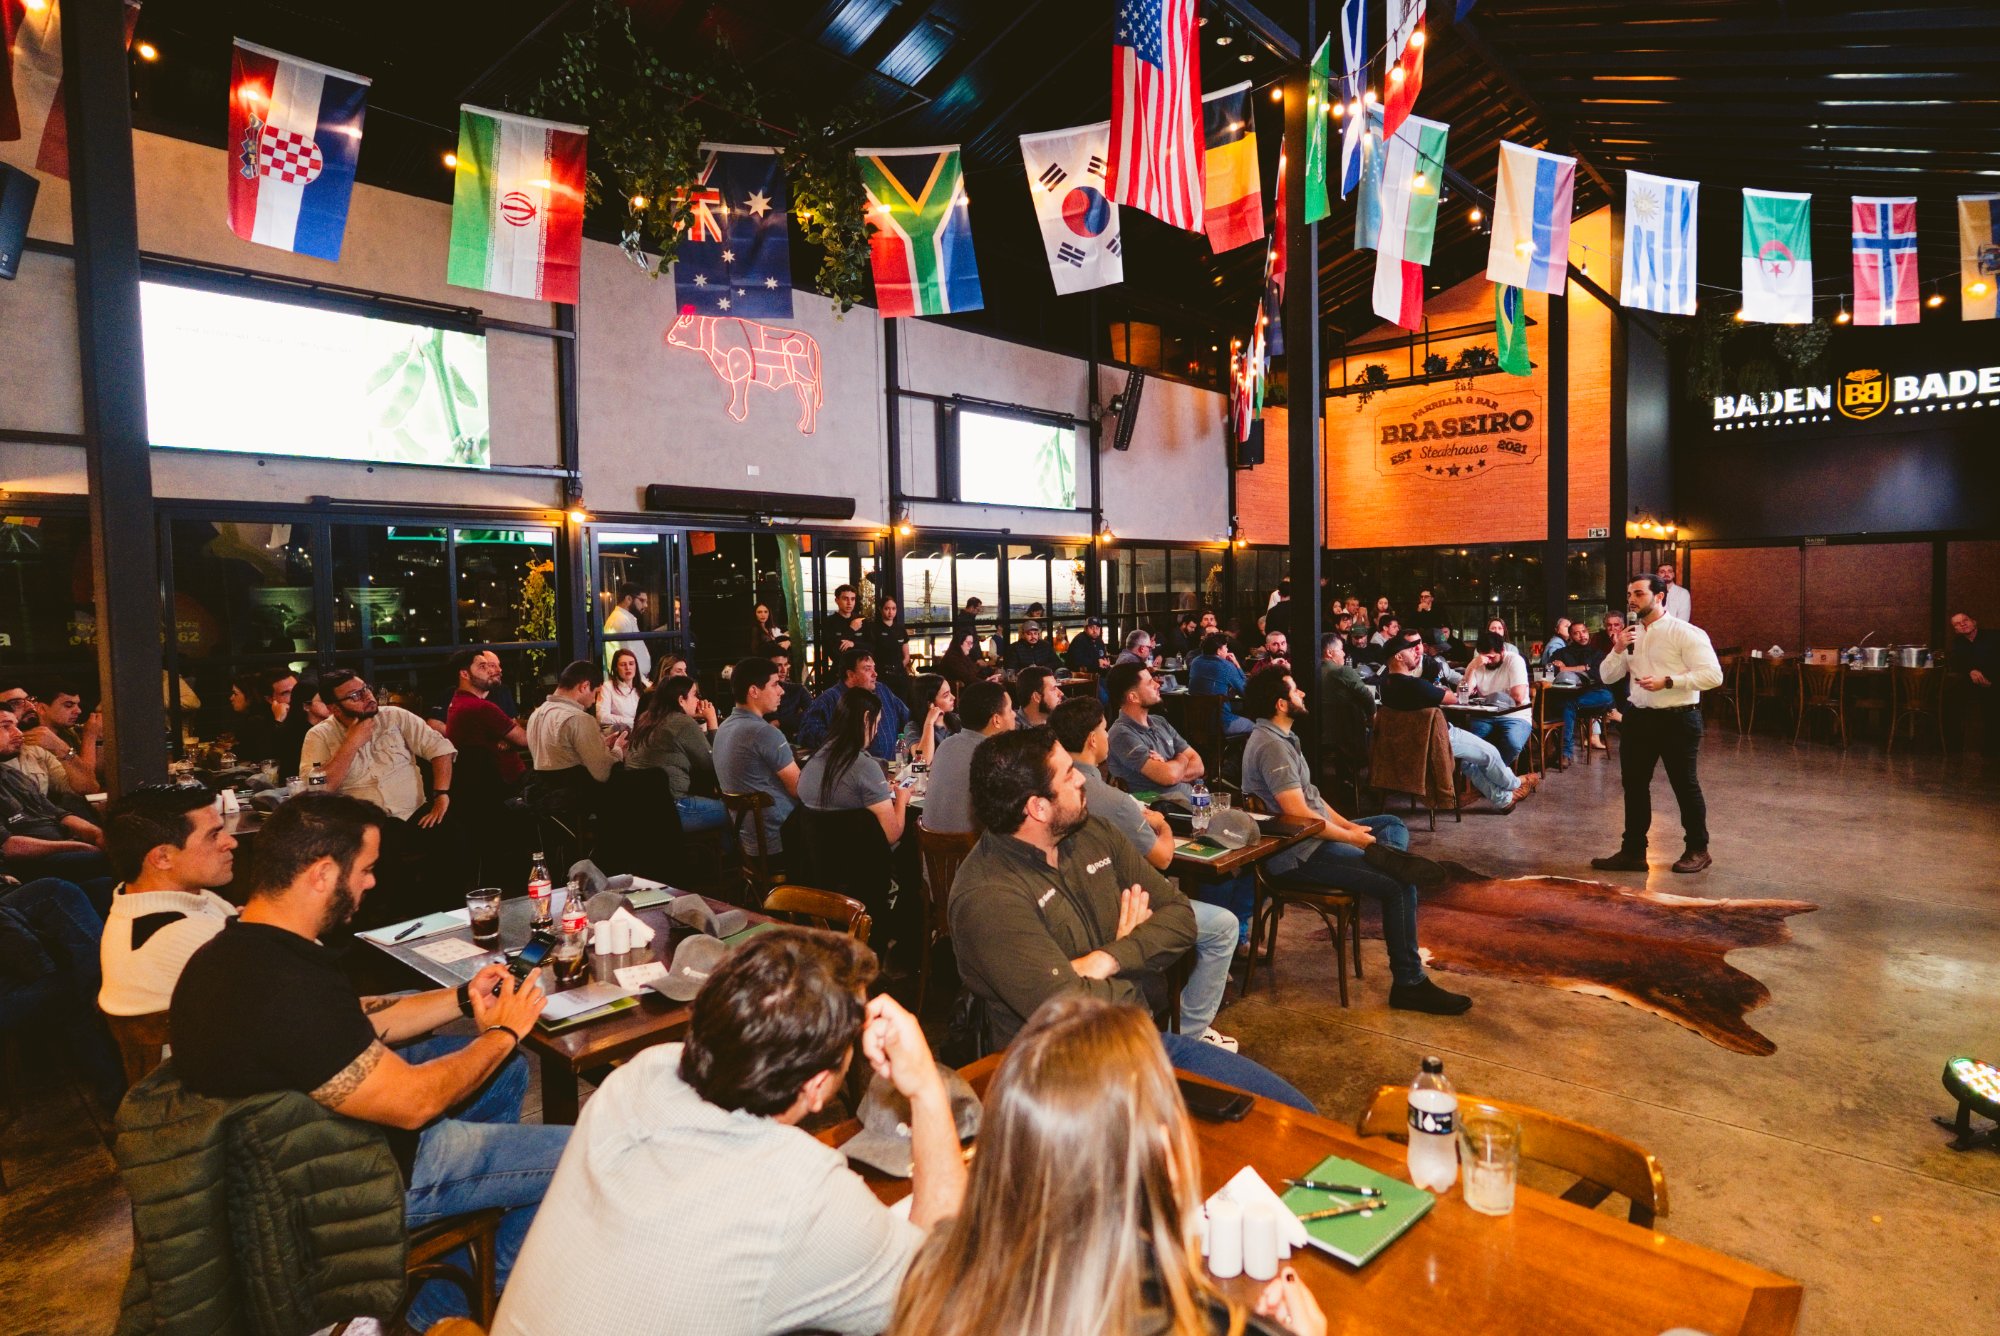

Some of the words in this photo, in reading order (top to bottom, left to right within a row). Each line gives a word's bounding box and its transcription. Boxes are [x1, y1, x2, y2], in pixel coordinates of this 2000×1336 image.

[1411, 396, 1463, 420] PARRILLA
[1475, 396, 1499, 411] BAR
[1713, 384, 1831, 419] BADEN
[1381, 409, 1534, 445] BRASEIRO
[1713, 414, 1831, 431] CERVEJARIA
[1390, 449, 1412, 465] EST
[1419, 444, 1489, 460] Steakhouse
[1497, 439, 1528, 455] 2021
